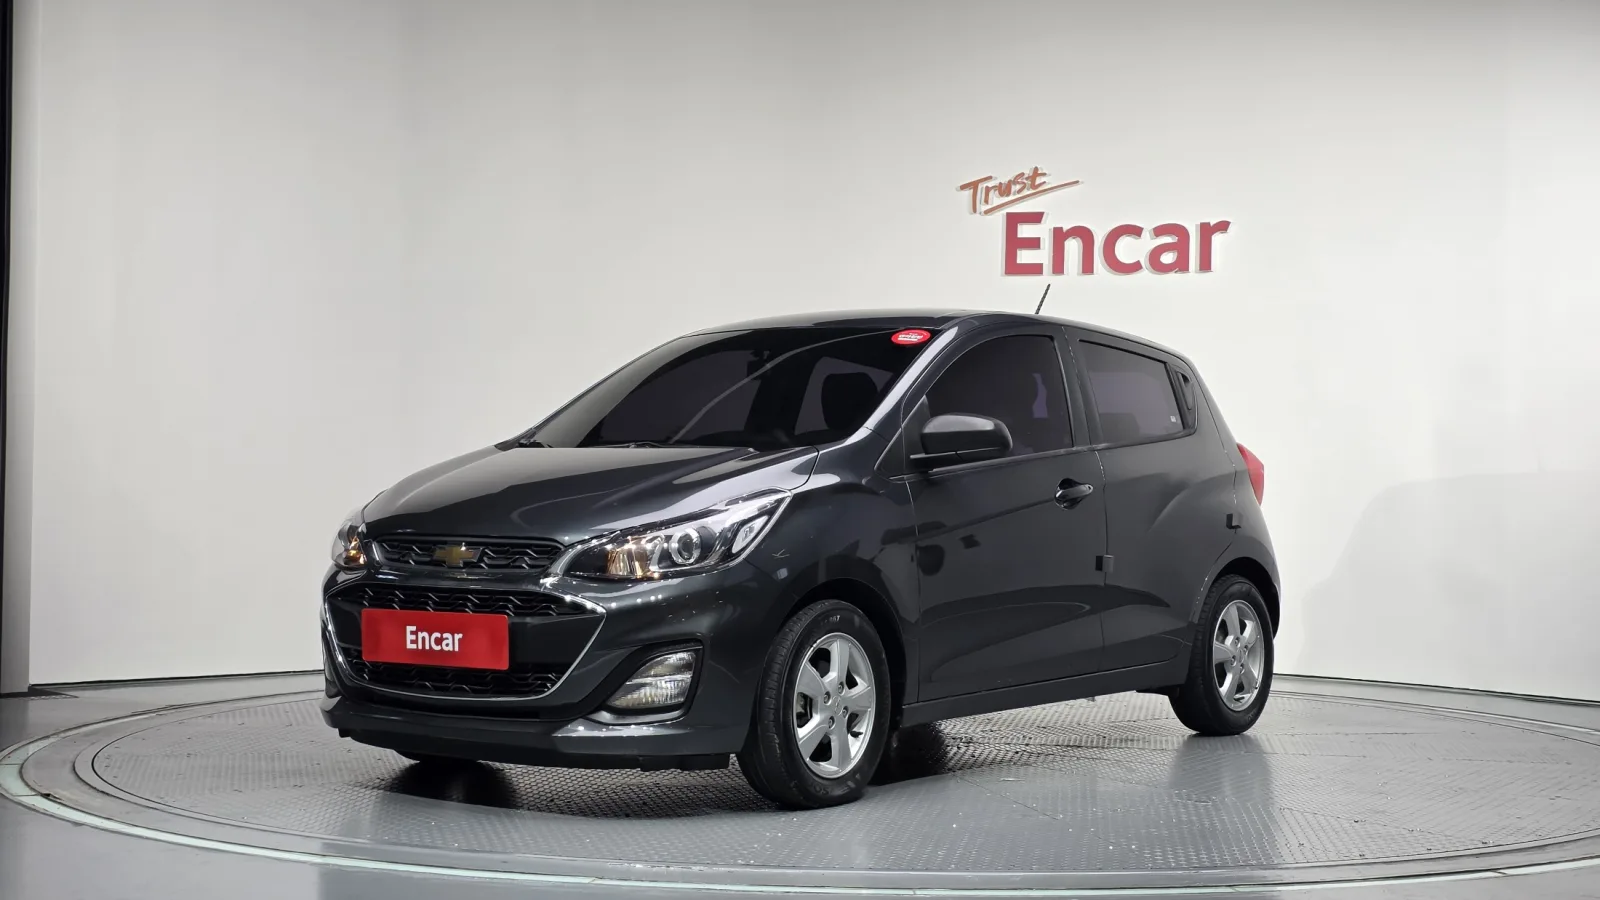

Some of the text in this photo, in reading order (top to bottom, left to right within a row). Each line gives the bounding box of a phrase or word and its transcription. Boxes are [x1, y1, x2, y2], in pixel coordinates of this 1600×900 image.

[959, 166, 1048, 214] Trust
[1003, 211, 1232, 275] Encar
[405, 625, 463, 652] Encar
